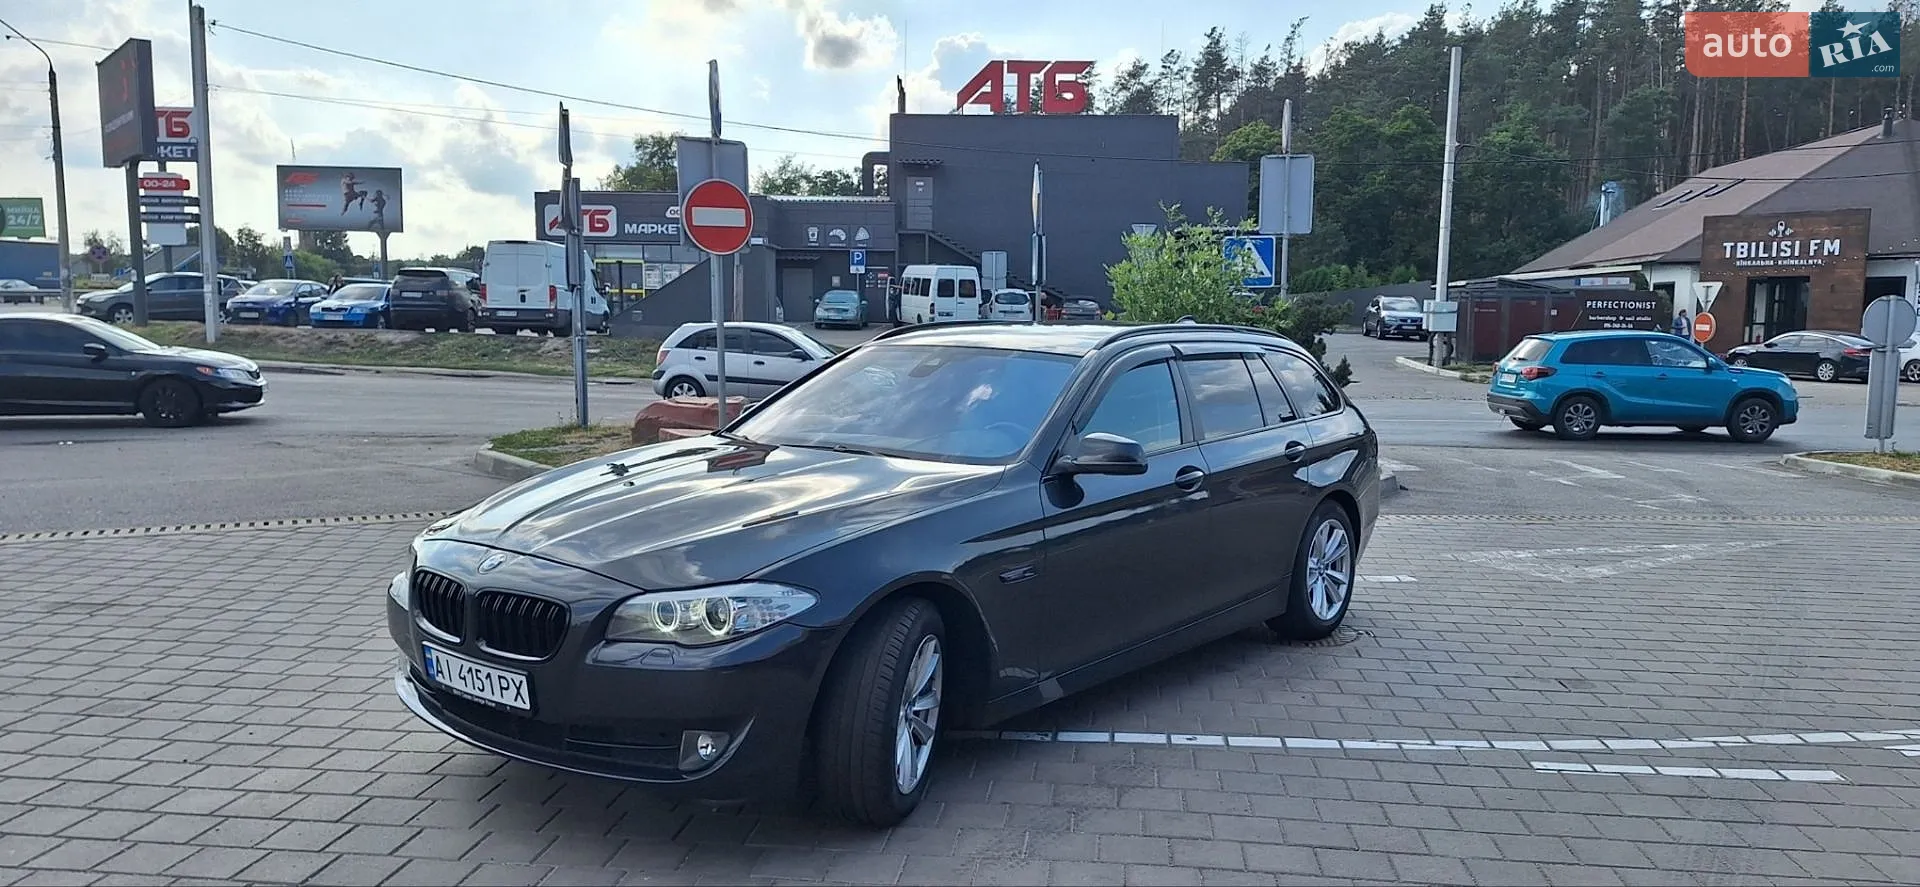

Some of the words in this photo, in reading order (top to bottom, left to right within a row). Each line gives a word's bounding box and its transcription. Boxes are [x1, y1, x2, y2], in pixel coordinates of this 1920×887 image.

[956, 60, 1095, 114] АТБ
[154, 110, 193, 138] ТБ
[7, 213, 41, 226] 24/7
[624, 223, 680, 235] МАРКЕ
[1723, 240, 1800, 259] TBILISI
[1809, 239, 1840, 256] FM
[1586, 301, 1657, 309] PERFECTIONIST
[436, 655, 453, 683] AI
[458, 663, 495, 697] 4151
[497, 674, 527, 705] PX
